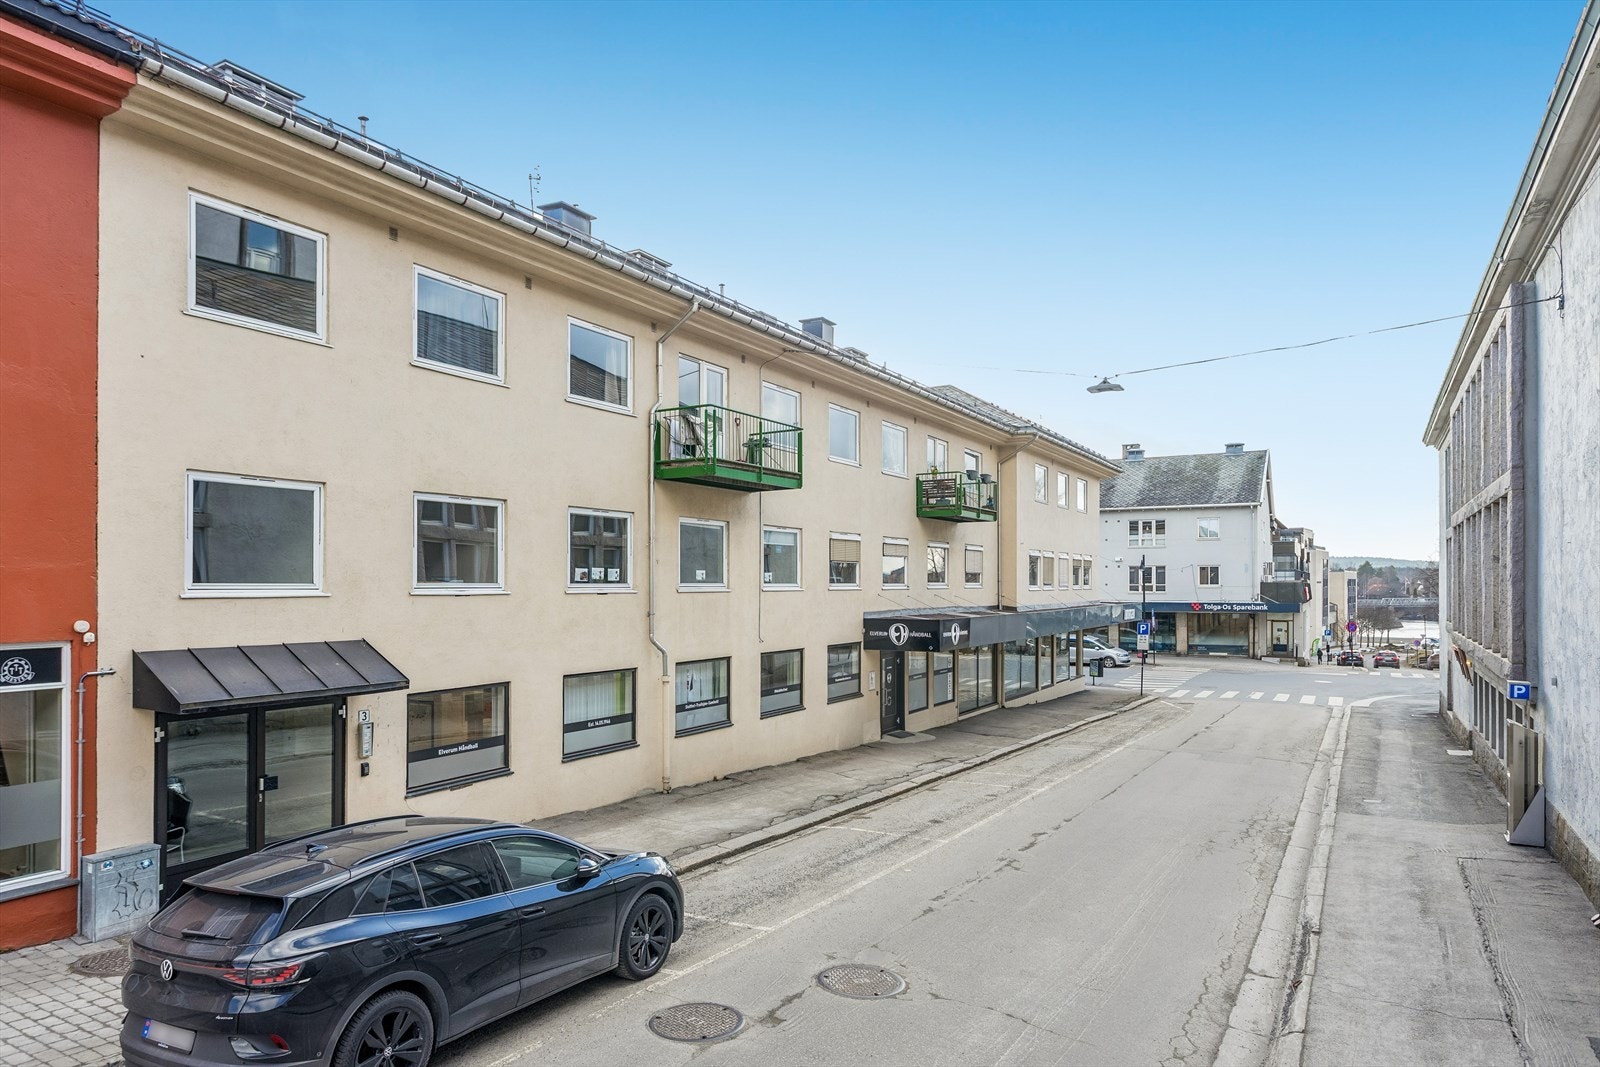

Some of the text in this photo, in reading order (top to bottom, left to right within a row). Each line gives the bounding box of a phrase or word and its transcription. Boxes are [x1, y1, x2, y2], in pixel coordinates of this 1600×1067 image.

[1203, 604, 1231, 612] Tolga-Os
[1140, 624, 1147, 634] P
[1513, 685, 1526, 698] P
[361, 711, 367, 721] 3
[459, 743, 478, 751] Håndball
